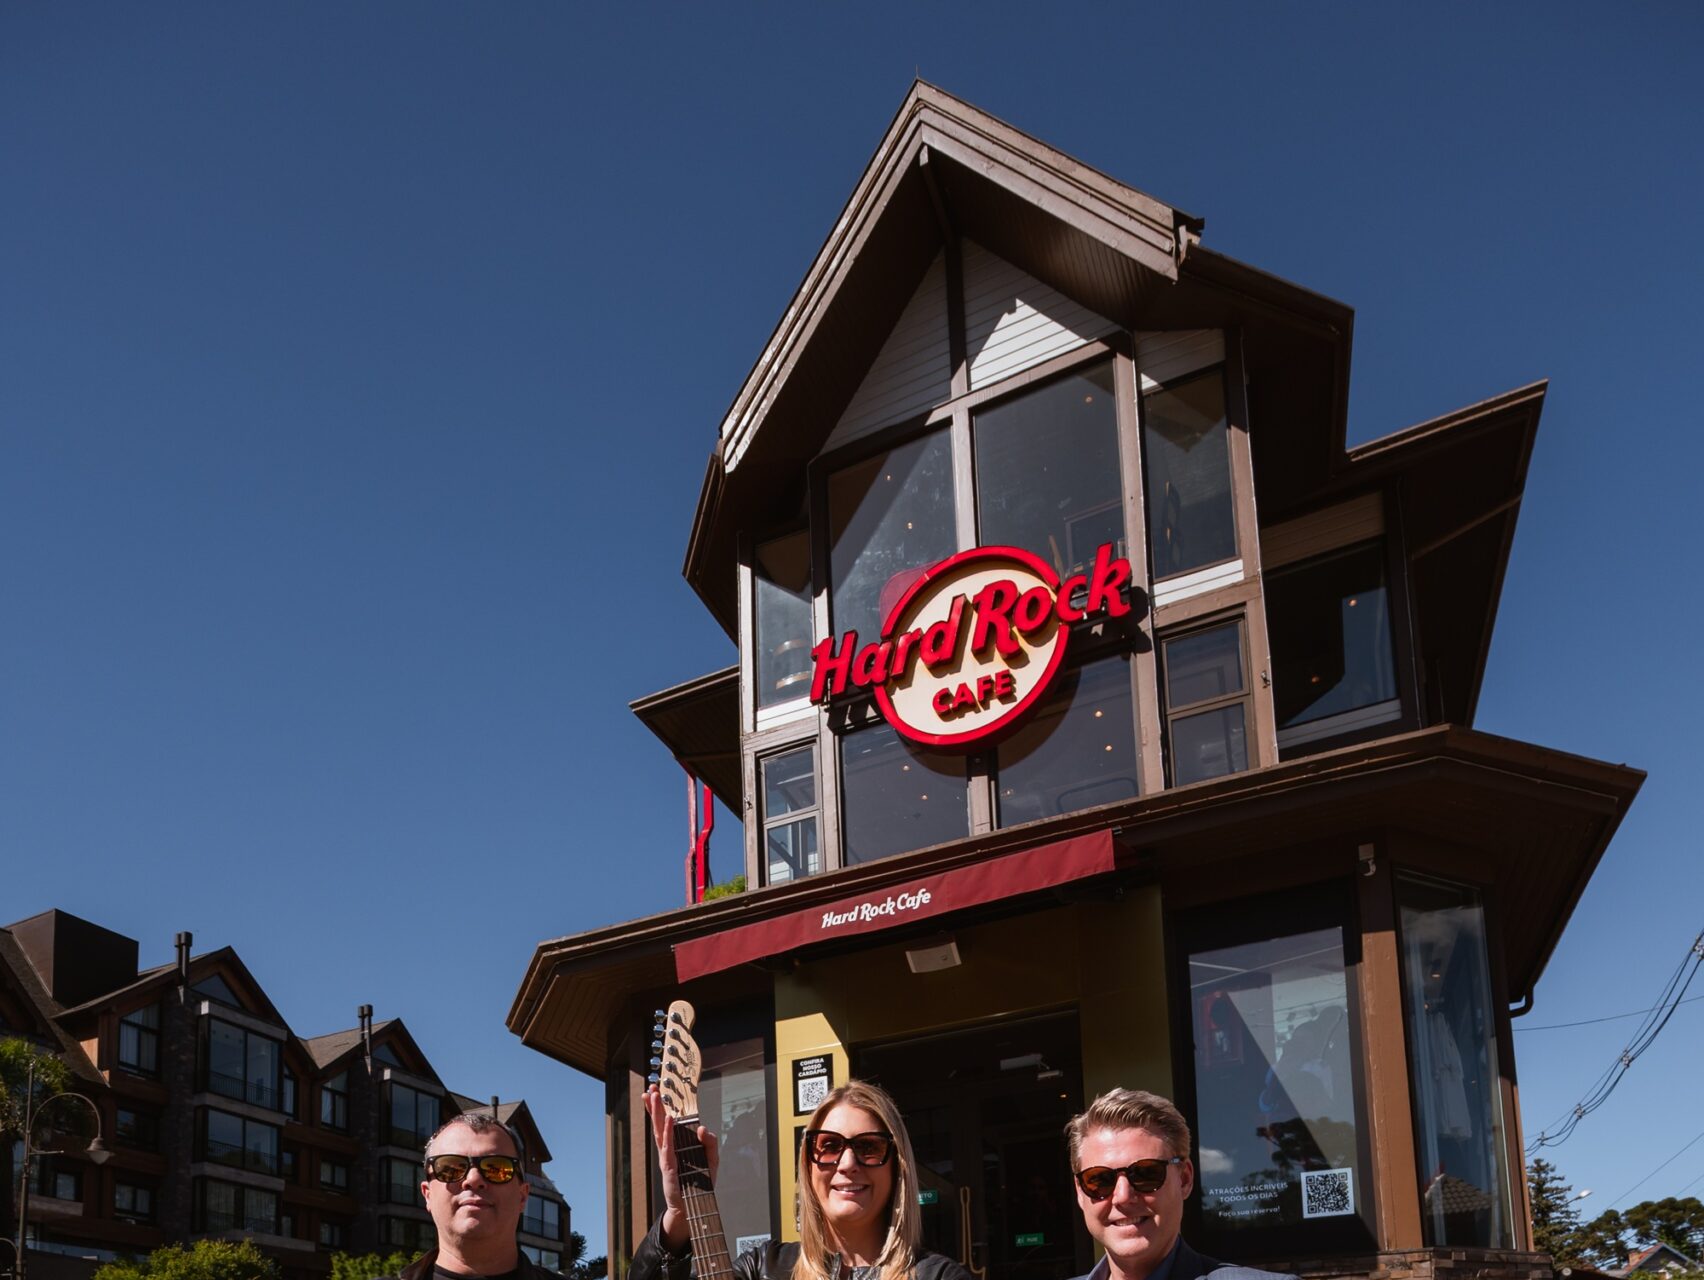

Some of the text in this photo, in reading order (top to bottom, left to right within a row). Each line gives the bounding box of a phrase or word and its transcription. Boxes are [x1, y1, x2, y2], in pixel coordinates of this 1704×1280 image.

[810, 542, 1132, 704] Hard Rock
[932, 669, 1013, 714] CAFE
[821, 888, 931, 929] Hard Rock Cafe
[1220, 1194, 1246, 1203] TODOS
[1260, 1191, 1278, 1199] DIAS
